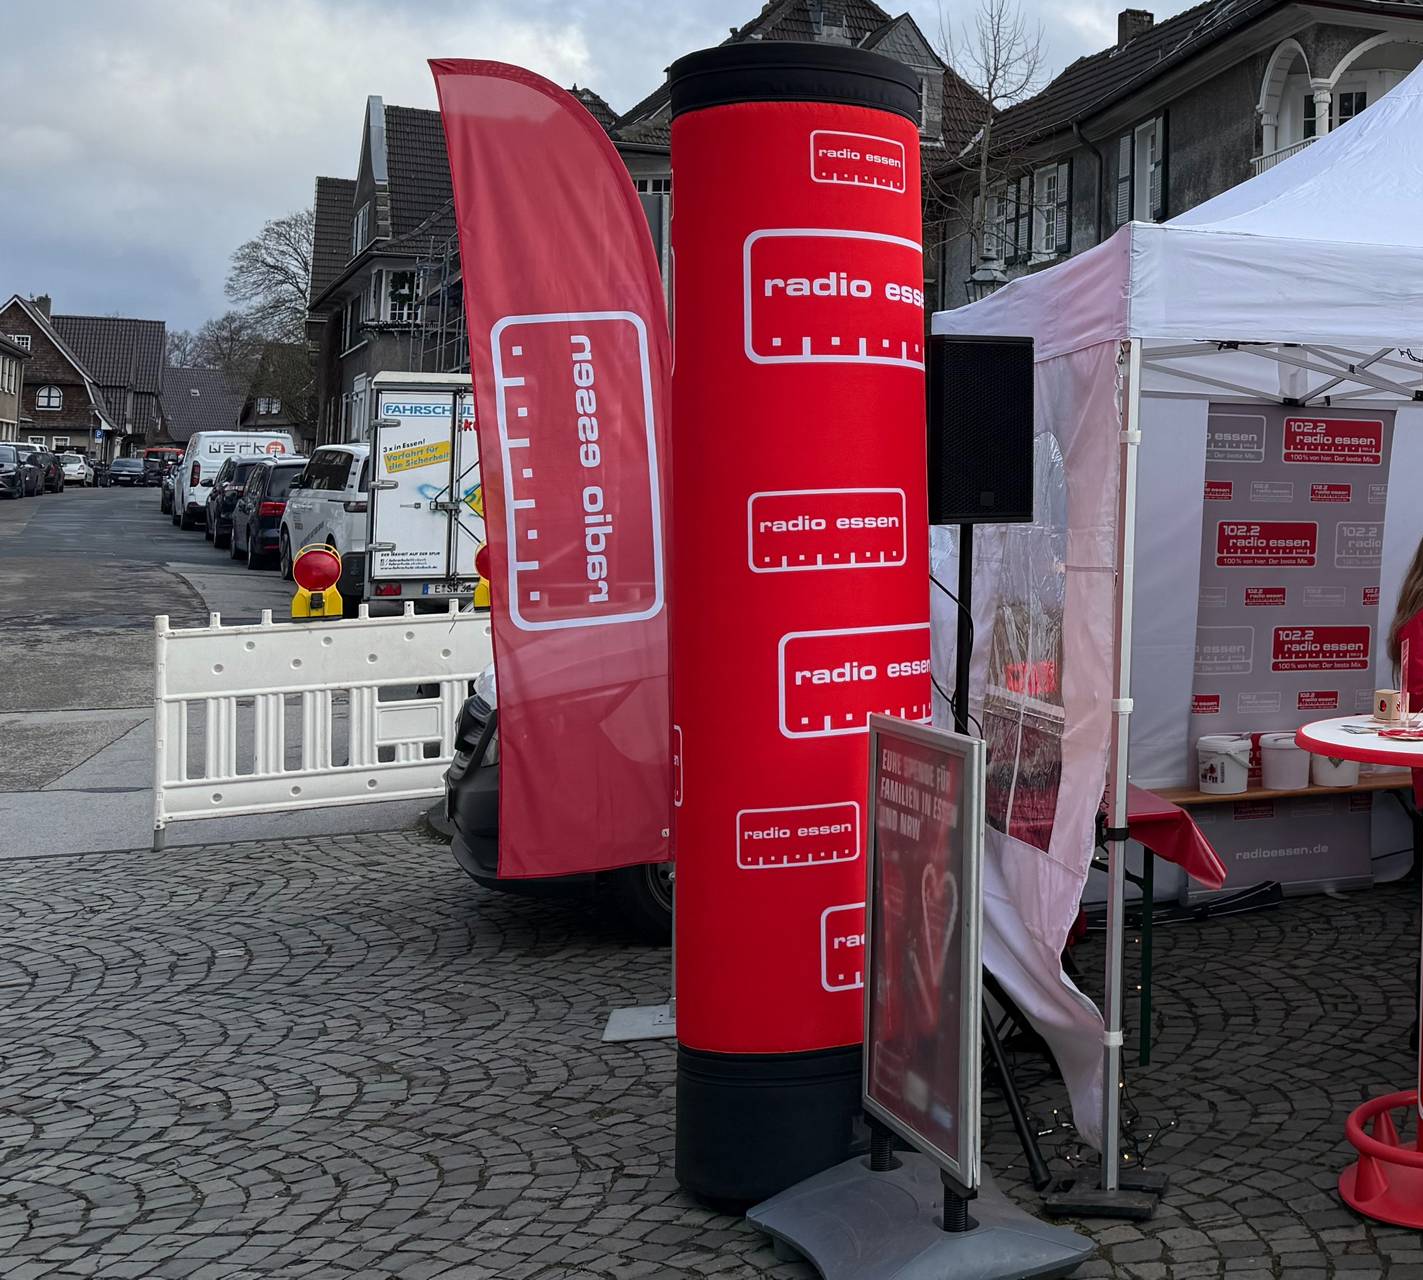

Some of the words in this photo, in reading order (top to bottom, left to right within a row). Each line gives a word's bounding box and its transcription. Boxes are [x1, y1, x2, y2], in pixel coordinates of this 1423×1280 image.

[818, 148, 861, 161] radio
[865, 152, 901, 168] essen
[764, 271, 872, 298] radio
[1289, 422, 1326, 433] 102.2
[1214, 433, 1257, 441] essen
[1296, 434, 1332, 444] radio
[1334, 437, 1376, 445] essen
[759, 515, 827, 533] radio
[835, 513, 899, 530] essen
[1223, 525, 1261, 536] 102.2
[1342, 527, 1378, 537] 102.2
[1229, 537, 1266, 547] radio
[1269, 539, 1310, 547] essen
[1278, 630, 1314, 641] 102.2
[1284, 641, 1321, 652] radio
[1322, 642, 1364, 651] essen
[795, 661, 877, 687] radio
[887, 658, 930, 678] essen
[880, 777, 919, 811] FAMILIEN
[921, 791, 931, 817] IN
[744, 826, 791, 840] radio
[797, 822, 852, 836] essen
[1235, 843, 1329, 861] radioessen.de
